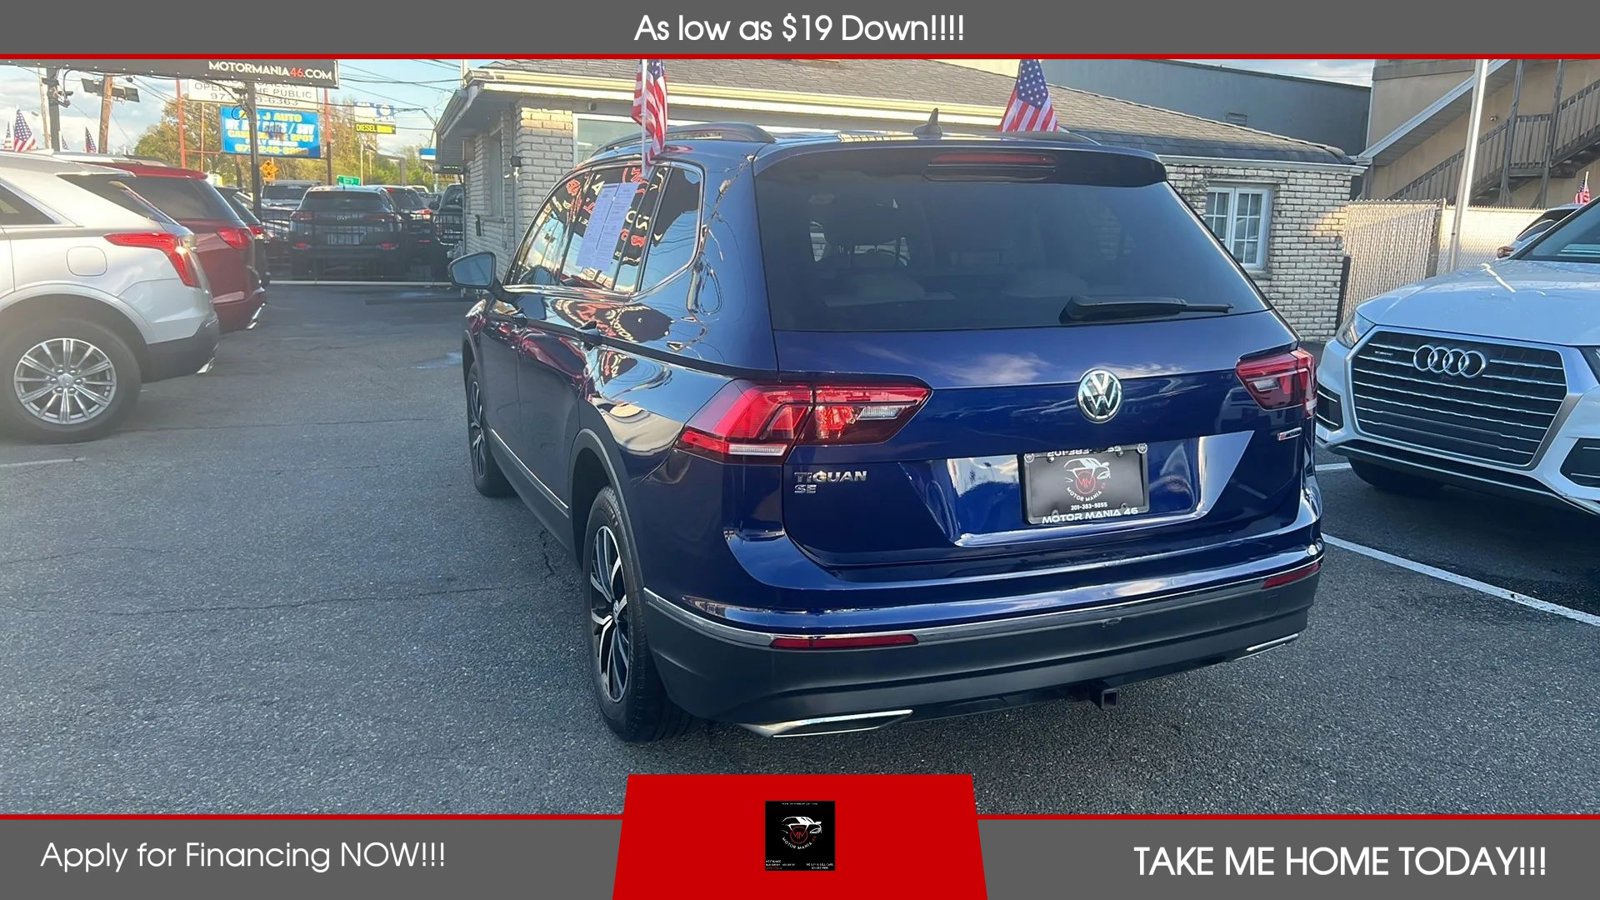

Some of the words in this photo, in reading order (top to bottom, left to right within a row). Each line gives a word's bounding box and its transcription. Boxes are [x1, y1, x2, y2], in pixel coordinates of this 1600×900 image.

[208, 60, 332, 80] MOTORMANIA46.COM
[273, 88, 312, 99] PUBLIC
[273, 112, 303, 123] AUTO
[262, 121, 288, 133] CARS
[793, 470, 868, 483] TIGUAN
[794, 484, 817, 494] SE
[1066, 487, 1084, 502] MOTOR
[1085, 490, 1102, 502] MANIA
[1041, 513, 1083, 524] MOTOR
[1084, 508, 1122, 520] MANIA
[1123, 506, 1140, 516] 46
